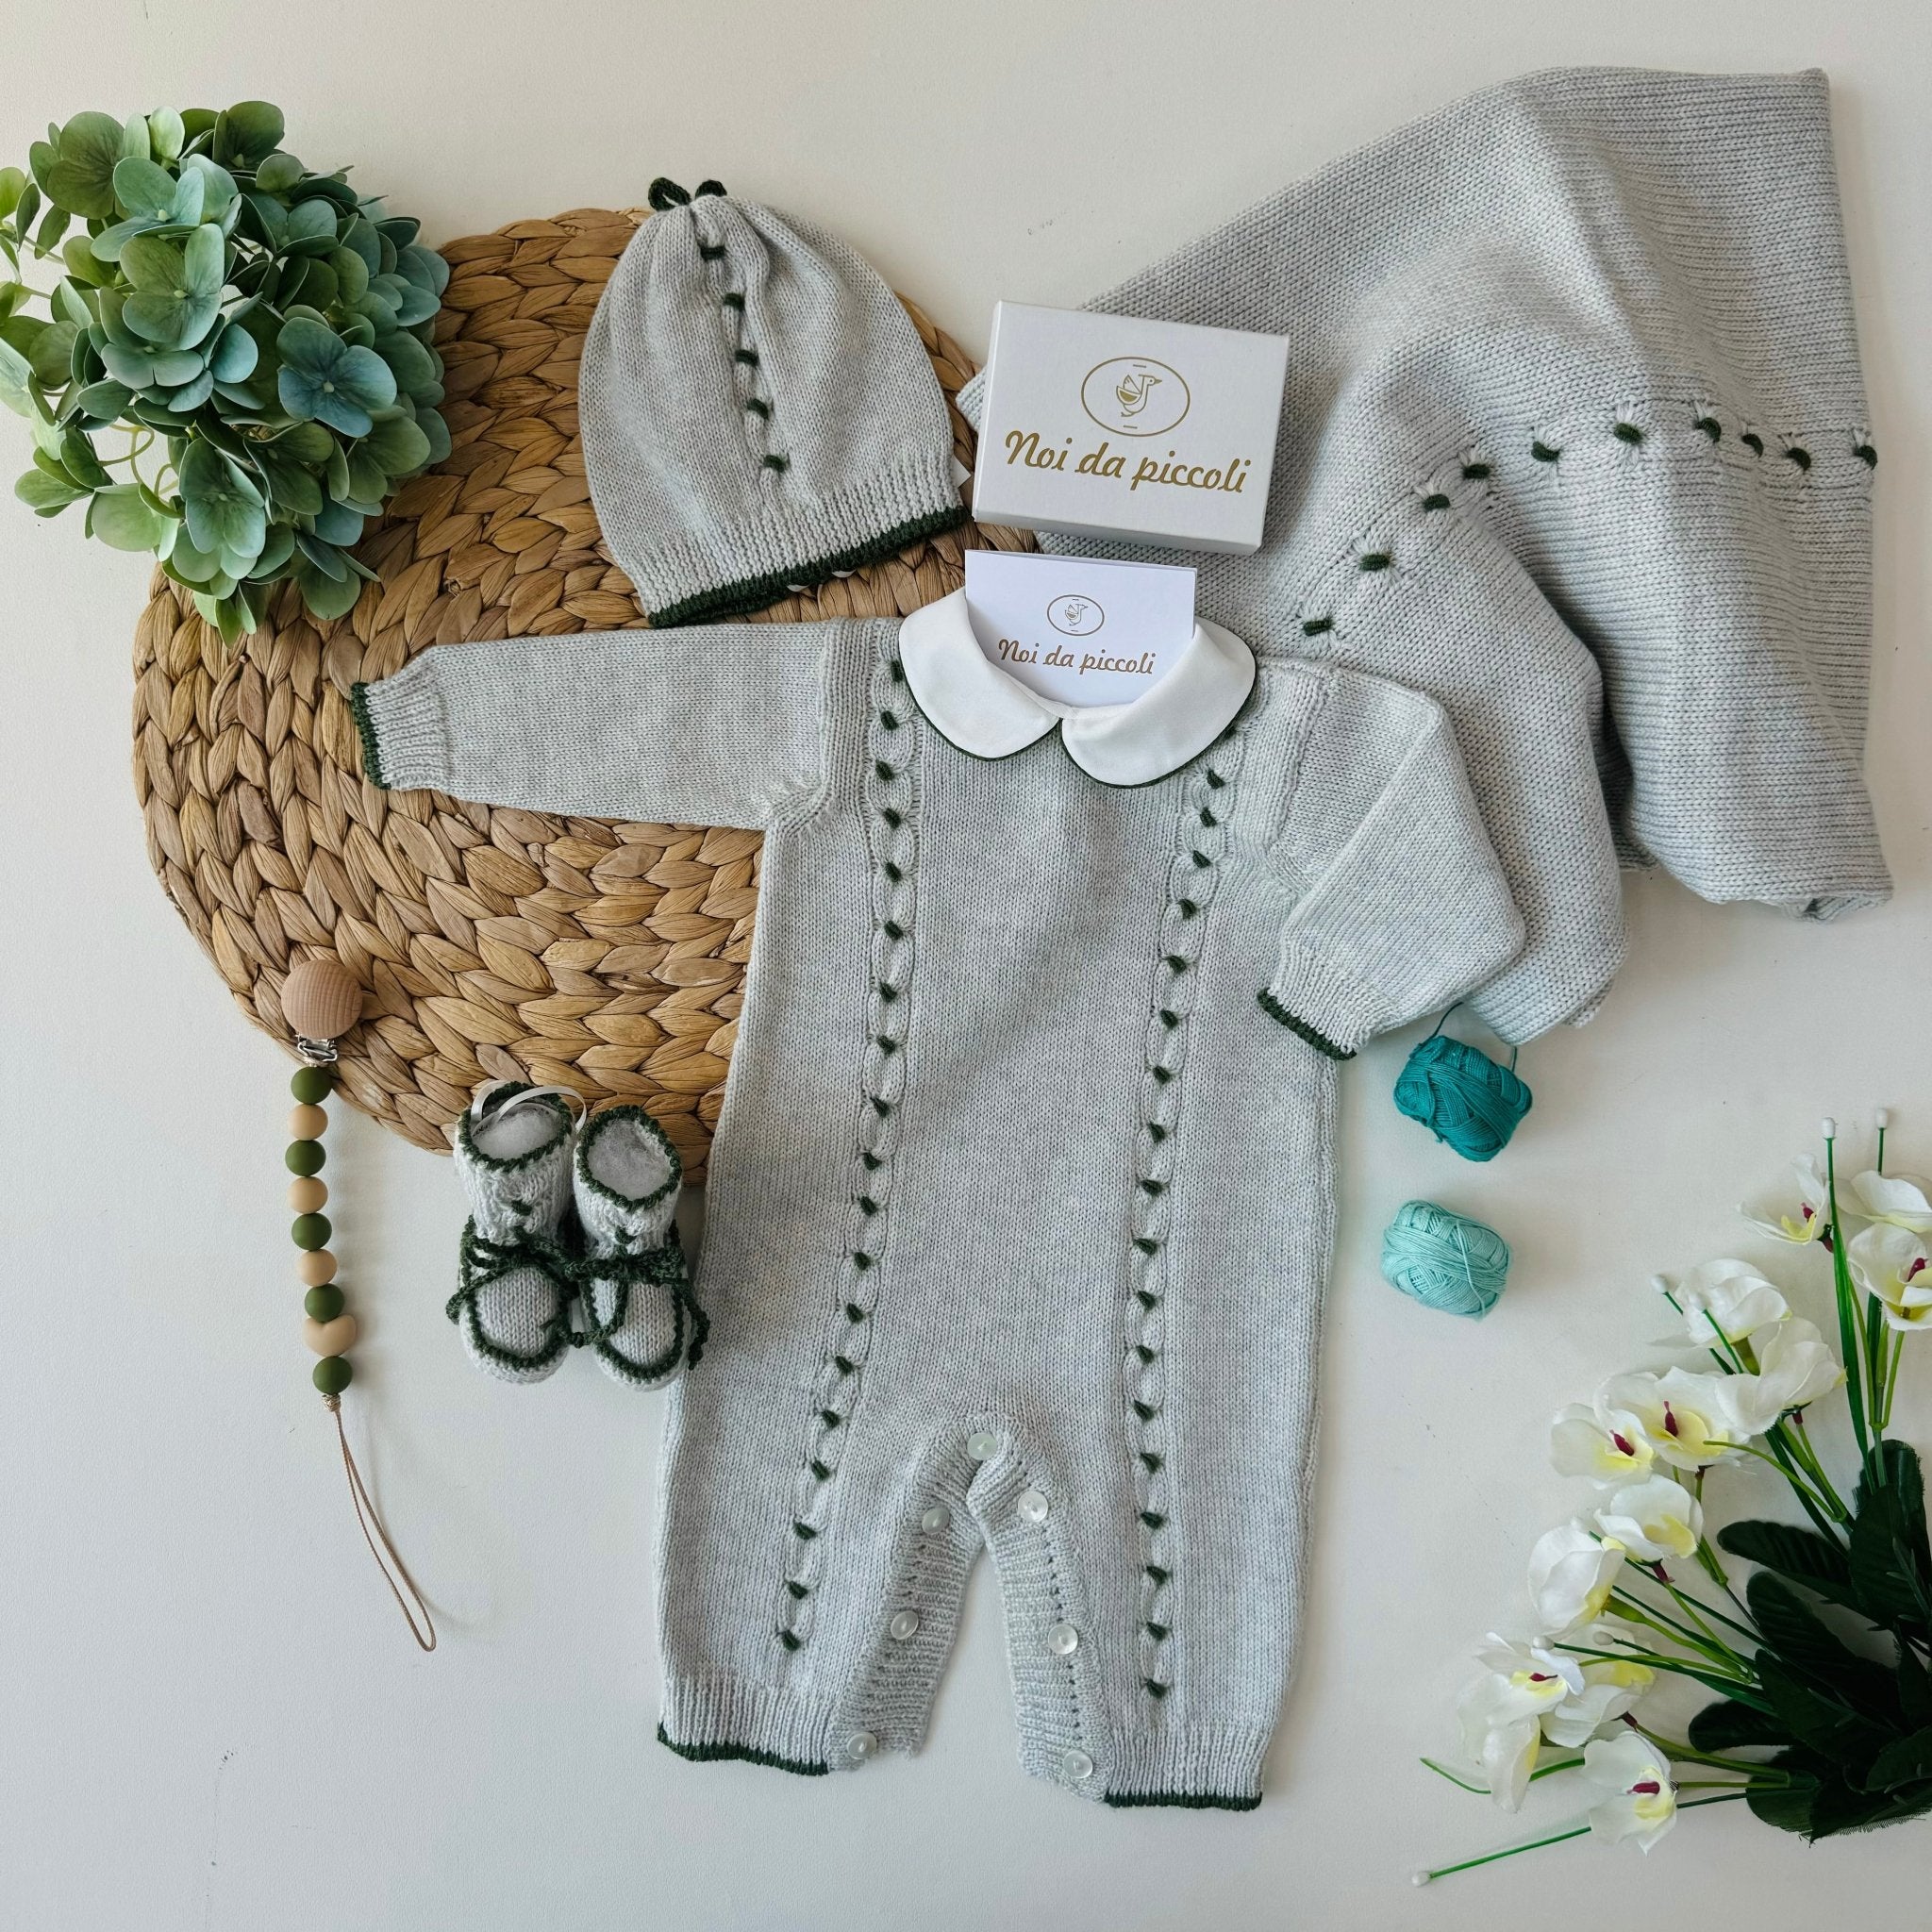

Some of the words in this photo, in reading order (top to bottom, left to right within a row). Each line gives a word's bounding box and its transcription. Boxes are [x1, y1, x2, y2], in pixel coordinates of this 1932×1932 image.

[1005, 430, 1073, 471] Noi
[1074, 442, 1126, 478] da
[1129, 450, 1251, 492] piccoli
[998, 639, 1040, 663] Noi
[1042, 644, 1074, 667] da
[1079, 649, 1157, 675] piccoli
